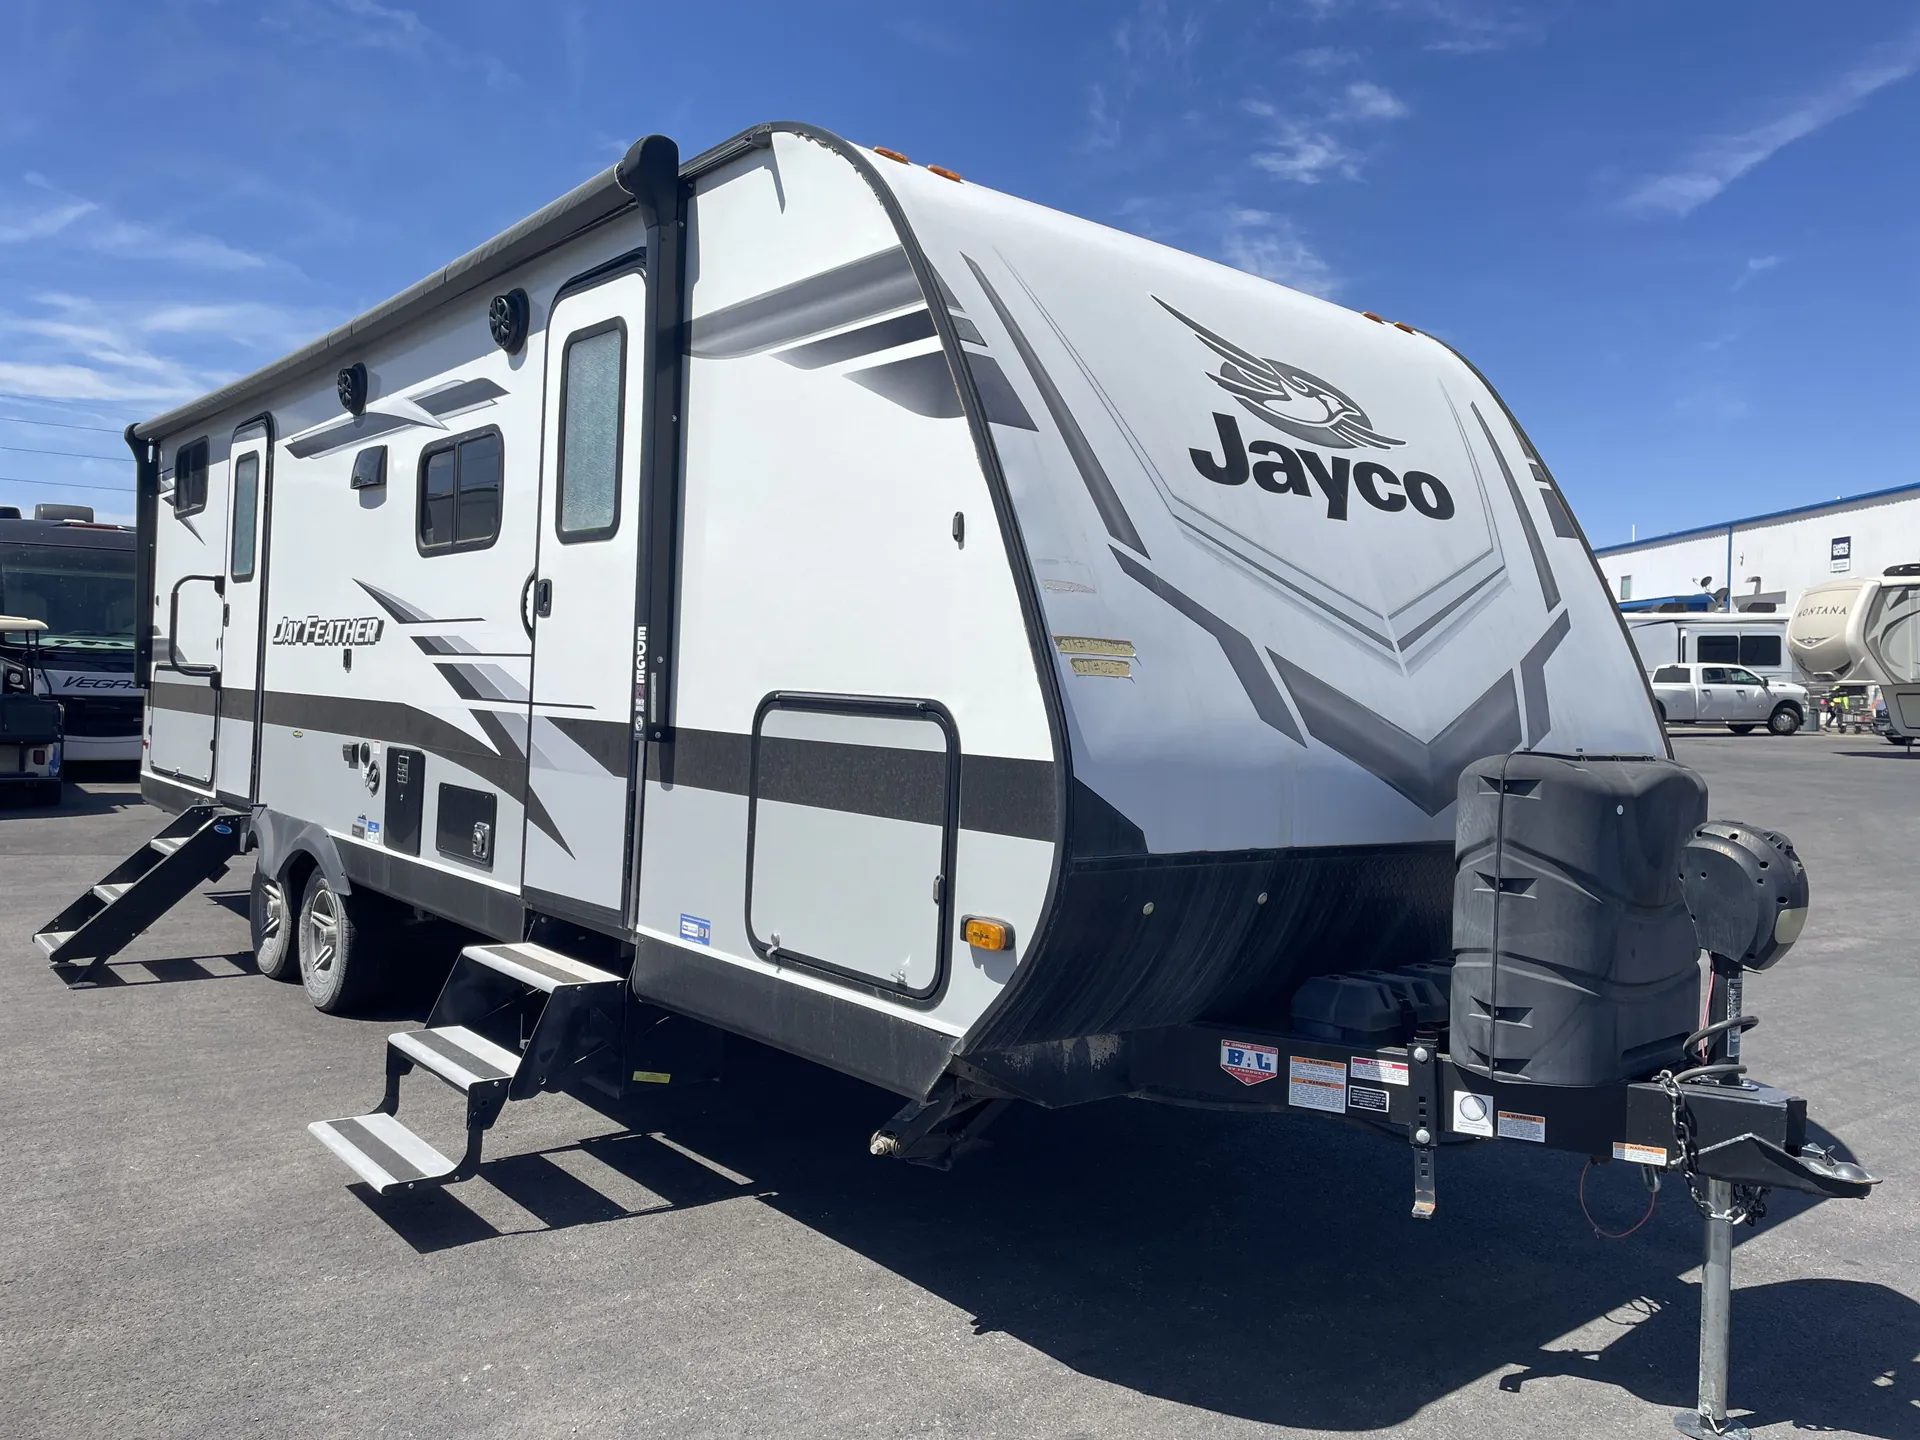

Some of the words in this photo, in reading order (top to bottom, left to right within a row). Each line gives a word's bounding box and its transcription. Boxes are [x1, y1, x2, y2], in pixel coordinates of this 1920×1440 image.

[1188, 411, 1455, 521] Jayco
[273, 616, 302, 645] JAY
[303, 615, 380, 646] FEATHER
[636, 626, 646, 684] EDGE
[1511, 1114, 1537, 1122] WARNING
